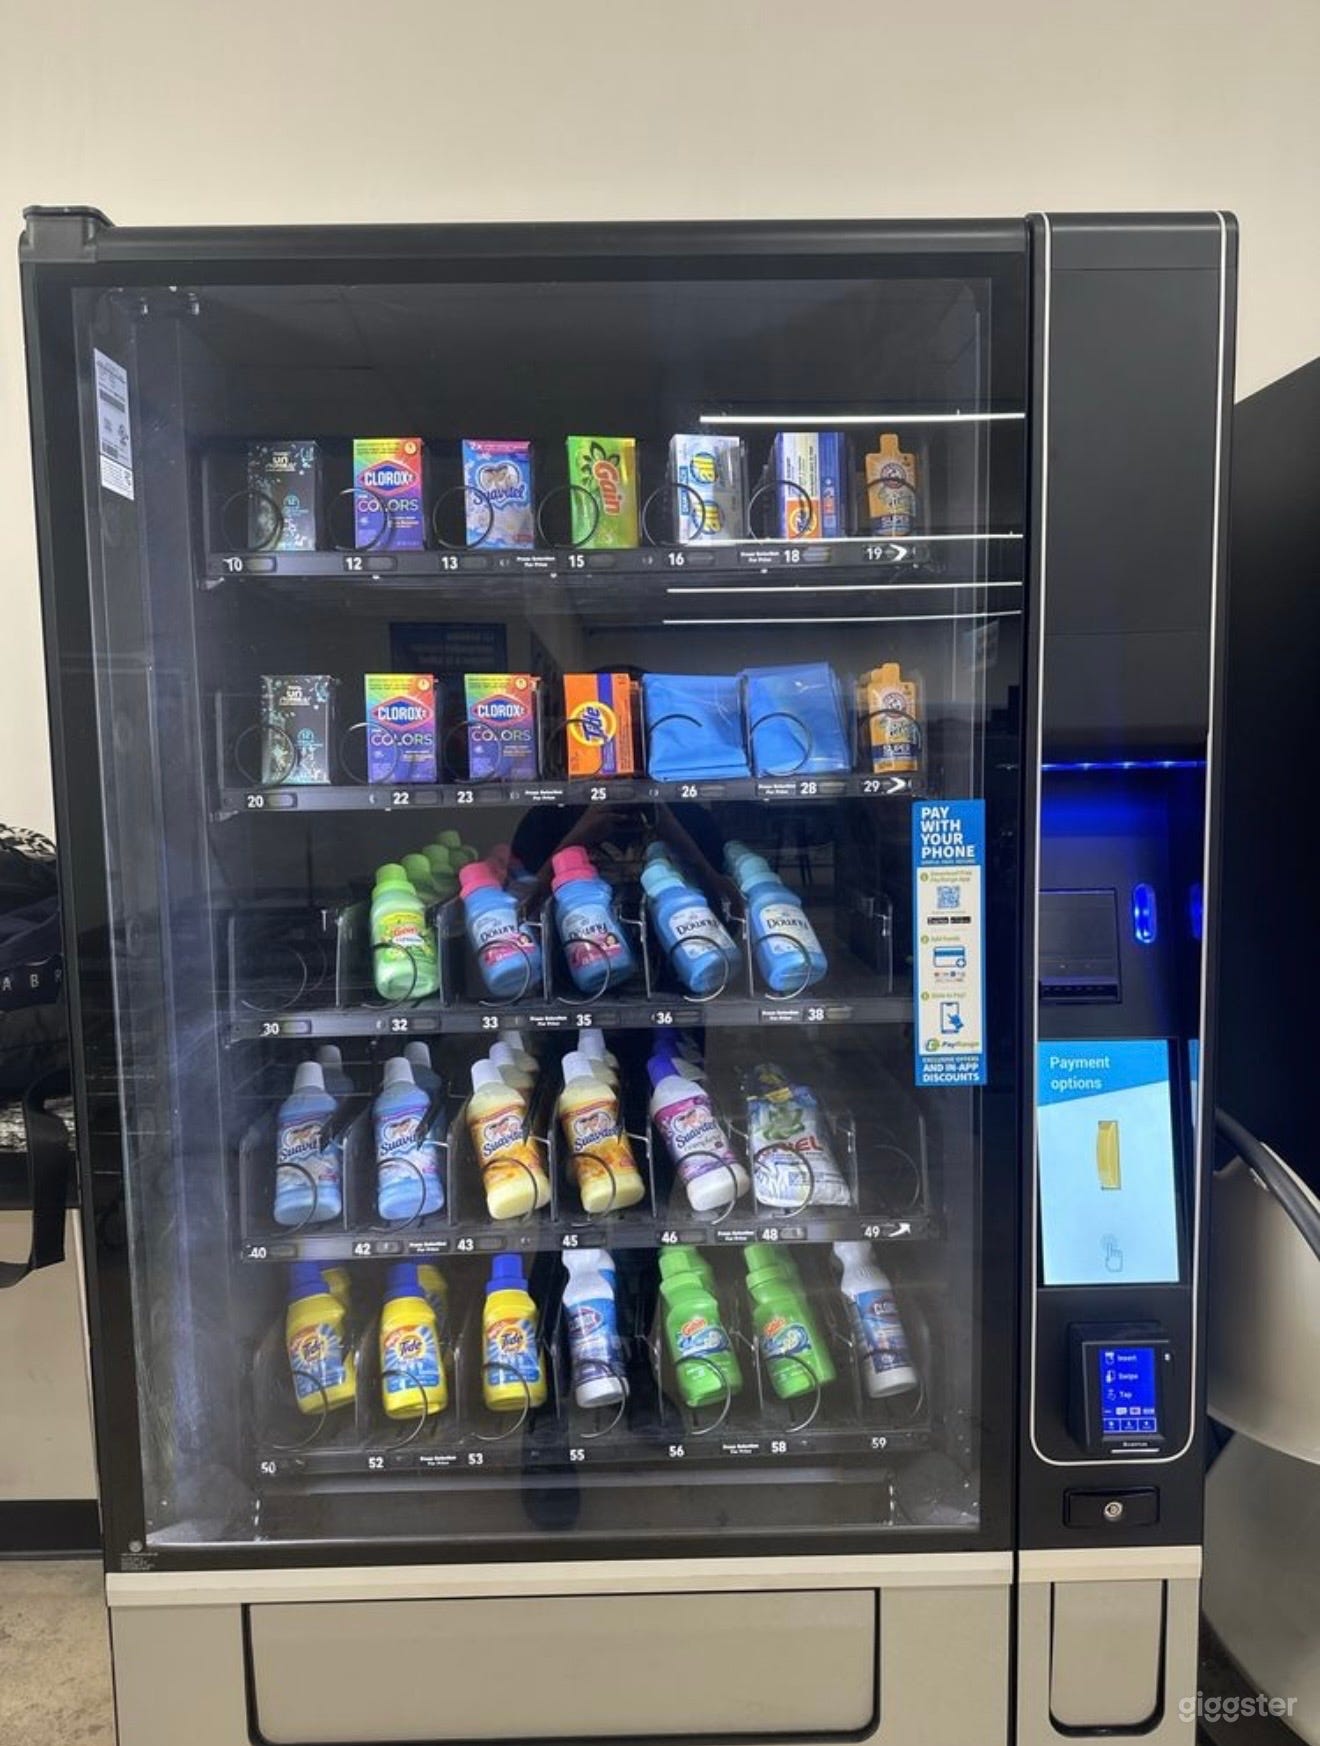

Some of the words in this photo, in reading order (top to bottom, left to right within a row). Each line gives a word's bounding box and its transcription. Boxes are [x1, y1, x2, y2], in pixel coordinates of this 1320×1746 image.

[364, 470, 409, 486] CLOROX
[592, 461, 622, 515] Gain
[668, 553, 685, 567] 16
[784, 548, 800, 563] 18
[866, 546, 883, 560] 19
[226, 557, 243, 571] 10
[346, 556, 363, 570] 12
[441, 556, 459, 570] 13
[568, 554, 585, 568] 15
[377, 706, 422, 720] CLOROX
[478, 704, 521, 718] CLOROX
[472, 729, 531, 742] COORS
[590, 787, 607, 800] 25
[682, 785, 698, 799] 26
[801, 781, 817, 795] 28
[864, 780, 880, 793] 29
[247, 794, 264, 808] 20
[393, 791, 409, 805] 22
[457, 791, 474, 804] 23
[921, 806, 949, 819] PAY
[920, 819, 961, 832] WITH
[921, 833, 964, 845] YOUR
[921, 845, 976, 859] PHONE
[3, 976, 12, 991] A
[30, 973, 40, 988] B
[576, 1013, 592, 1027] 35
[656, 1011, 672, 1025] 36
[807, 1007, 824, 1021] 38
[263, 1022, 280, 1036] 30
[391, 1018, 408, 1031] 32
[482, 1016, 499, 1029] 33
[923, 1063, 944, 1072] AND
[1050, 1056, 1111, 1072] Payment
[923, 1072, 980, 1082] DISCOUNTS
[1051, 1076, 1102, 1092] options
[661, 1231, 678, 1244] 46
[762, 1228, 778, 1241] 48
[864, 1226, 880, 1239] 49
[457, 1238, 474, 1251] 43
[562, 1234, 578, 1247] 45
[250, 1246, 267, 1259] 40
[354, 1242, 371, 1255] 42
[1119, 1390, 1133, 1399] Tap
[771, 1440, 787, 1453] 58
[871, 1437, 888, 1450] 59
[569, 1449, 586, 1462] 55
[669, 1444, 685, 1458] 56
[368, 1455, 384, 1469] 52
[468, 1452, 484, 1465] 53
[261, 1462, 277, 1475] 50
